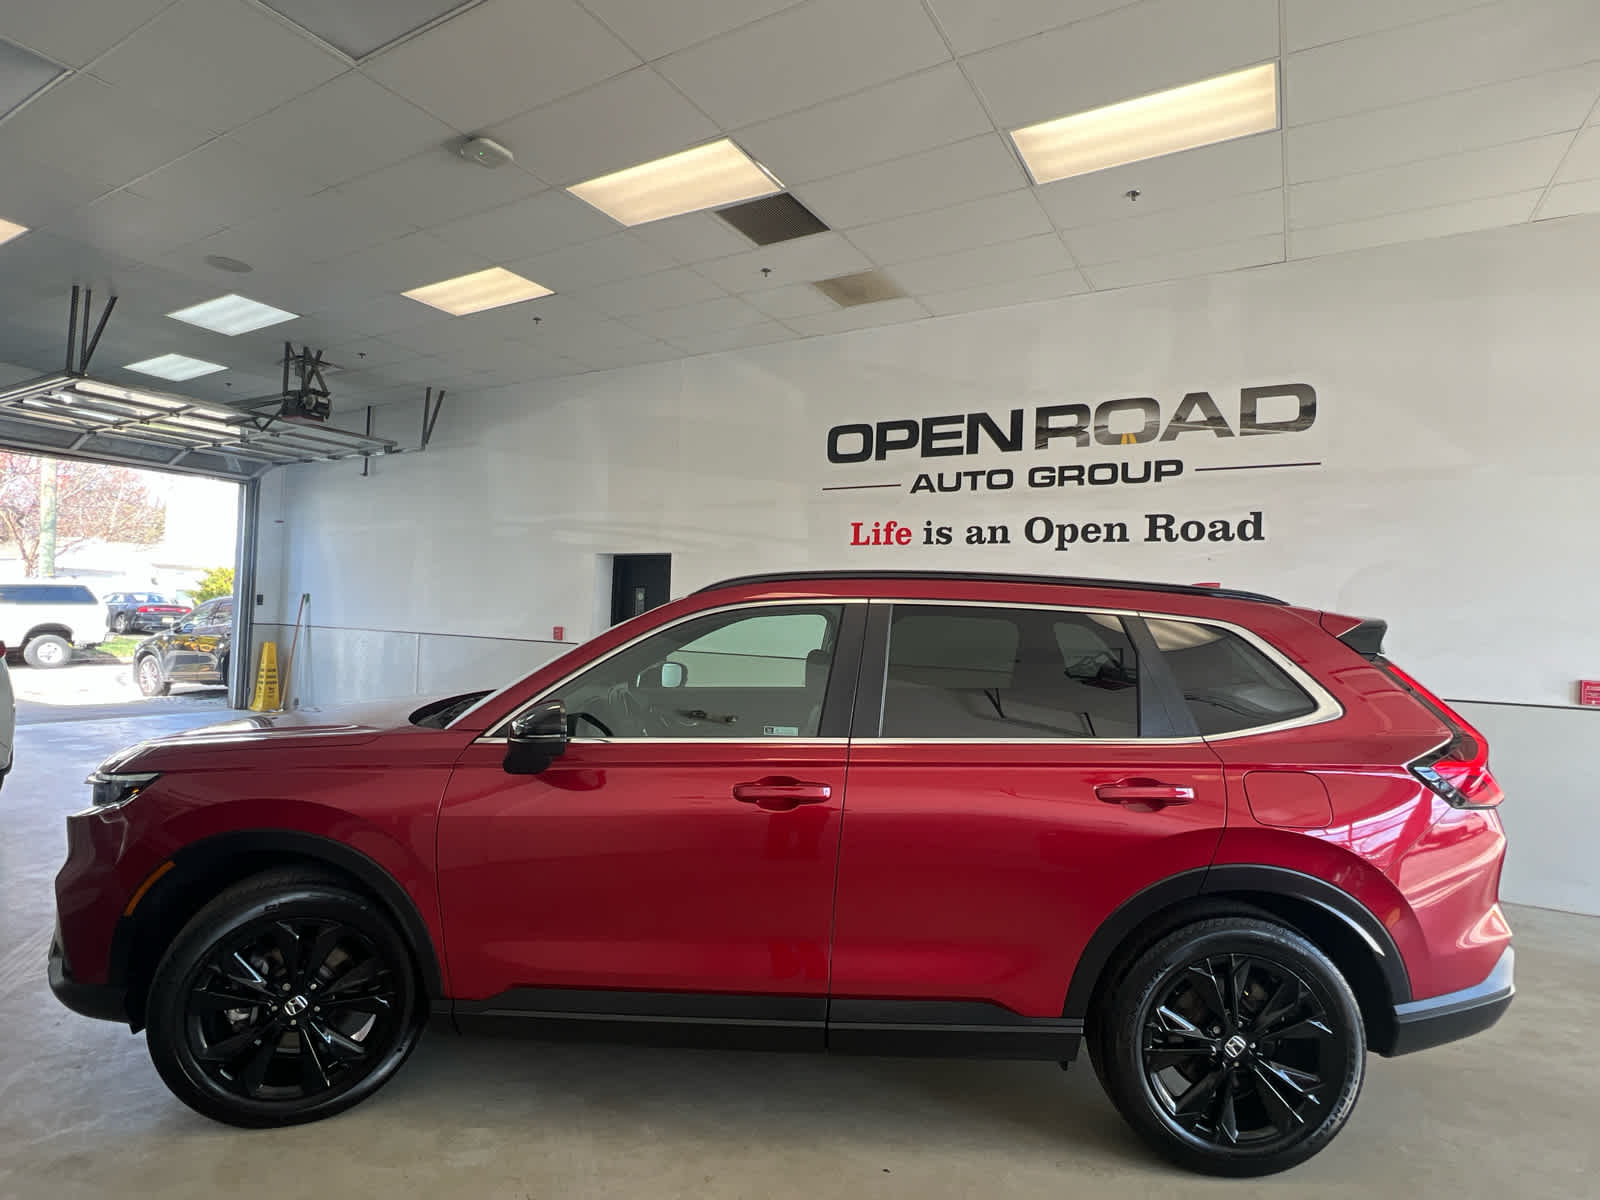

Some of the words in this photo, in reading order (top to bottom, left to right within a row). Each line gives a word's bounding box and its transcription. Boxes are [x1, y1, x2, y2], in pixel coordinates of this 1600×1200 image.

[910, 468, 1014, 494] AUTO
[1027, 459, 1184, 489] GROUP
[849, 520, 913, 546] Life
[922, 520, 953, 546] is
[965, 525, 1011, 545] an
[1024, 516, 1130, 552] Open
[1143, 511, 1265, 544] Road
